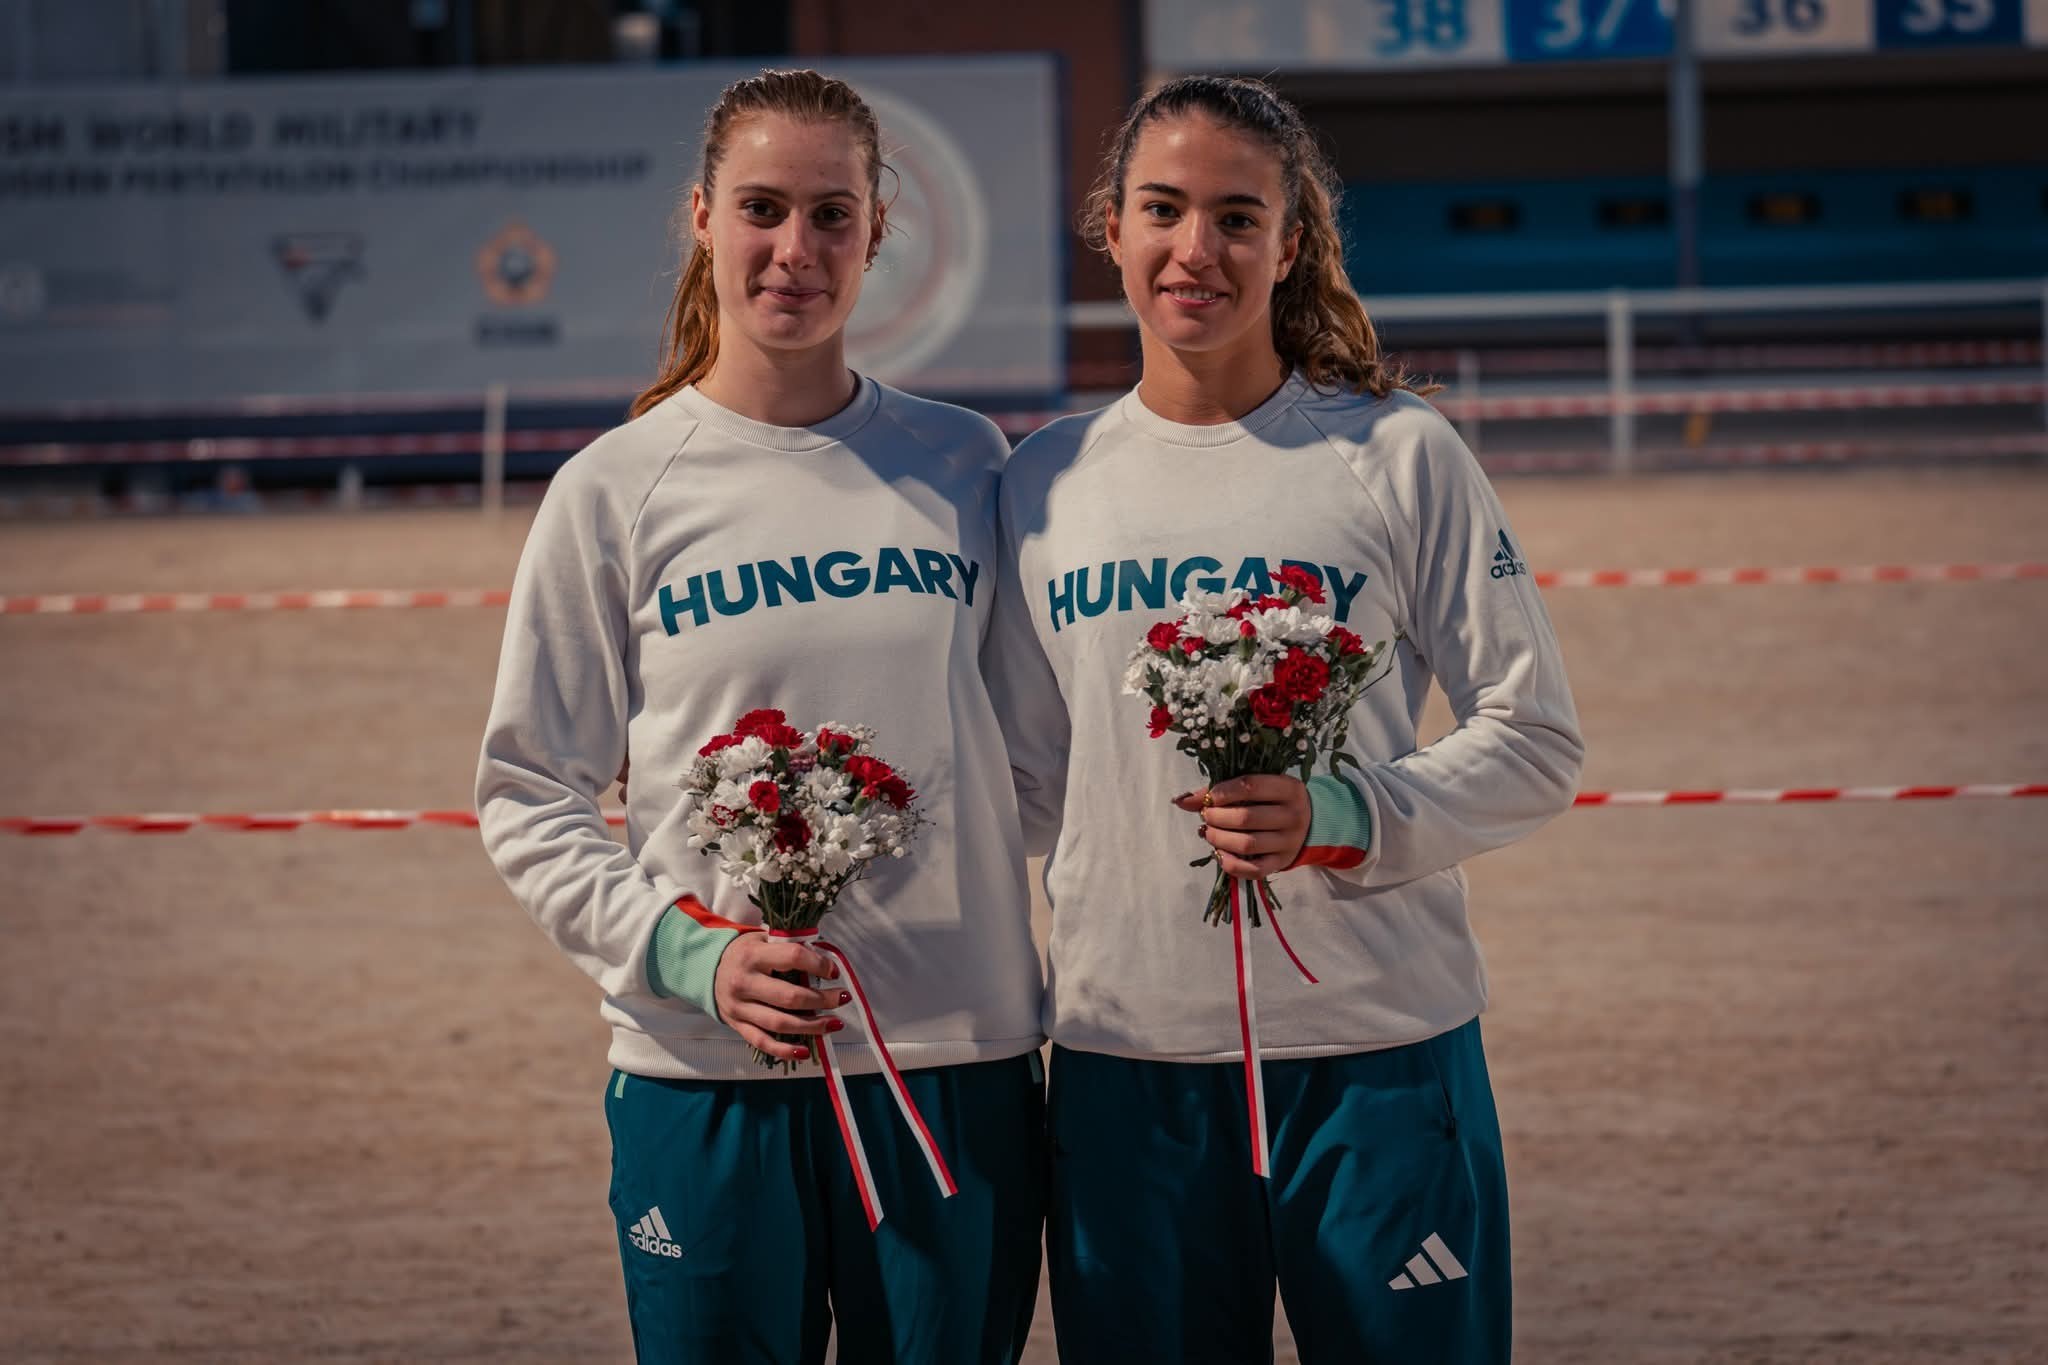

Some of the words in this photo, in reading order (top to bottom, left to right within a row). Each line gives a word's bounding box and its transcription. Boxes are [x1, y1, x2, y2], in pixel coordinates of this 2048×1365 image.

[1370, 0, 1471, 52] 38
[1538, 0, 1636, 49] 37
[658, 547, 979, 637] HUNGARY
[628, 1233, 683, 1259] adidas
